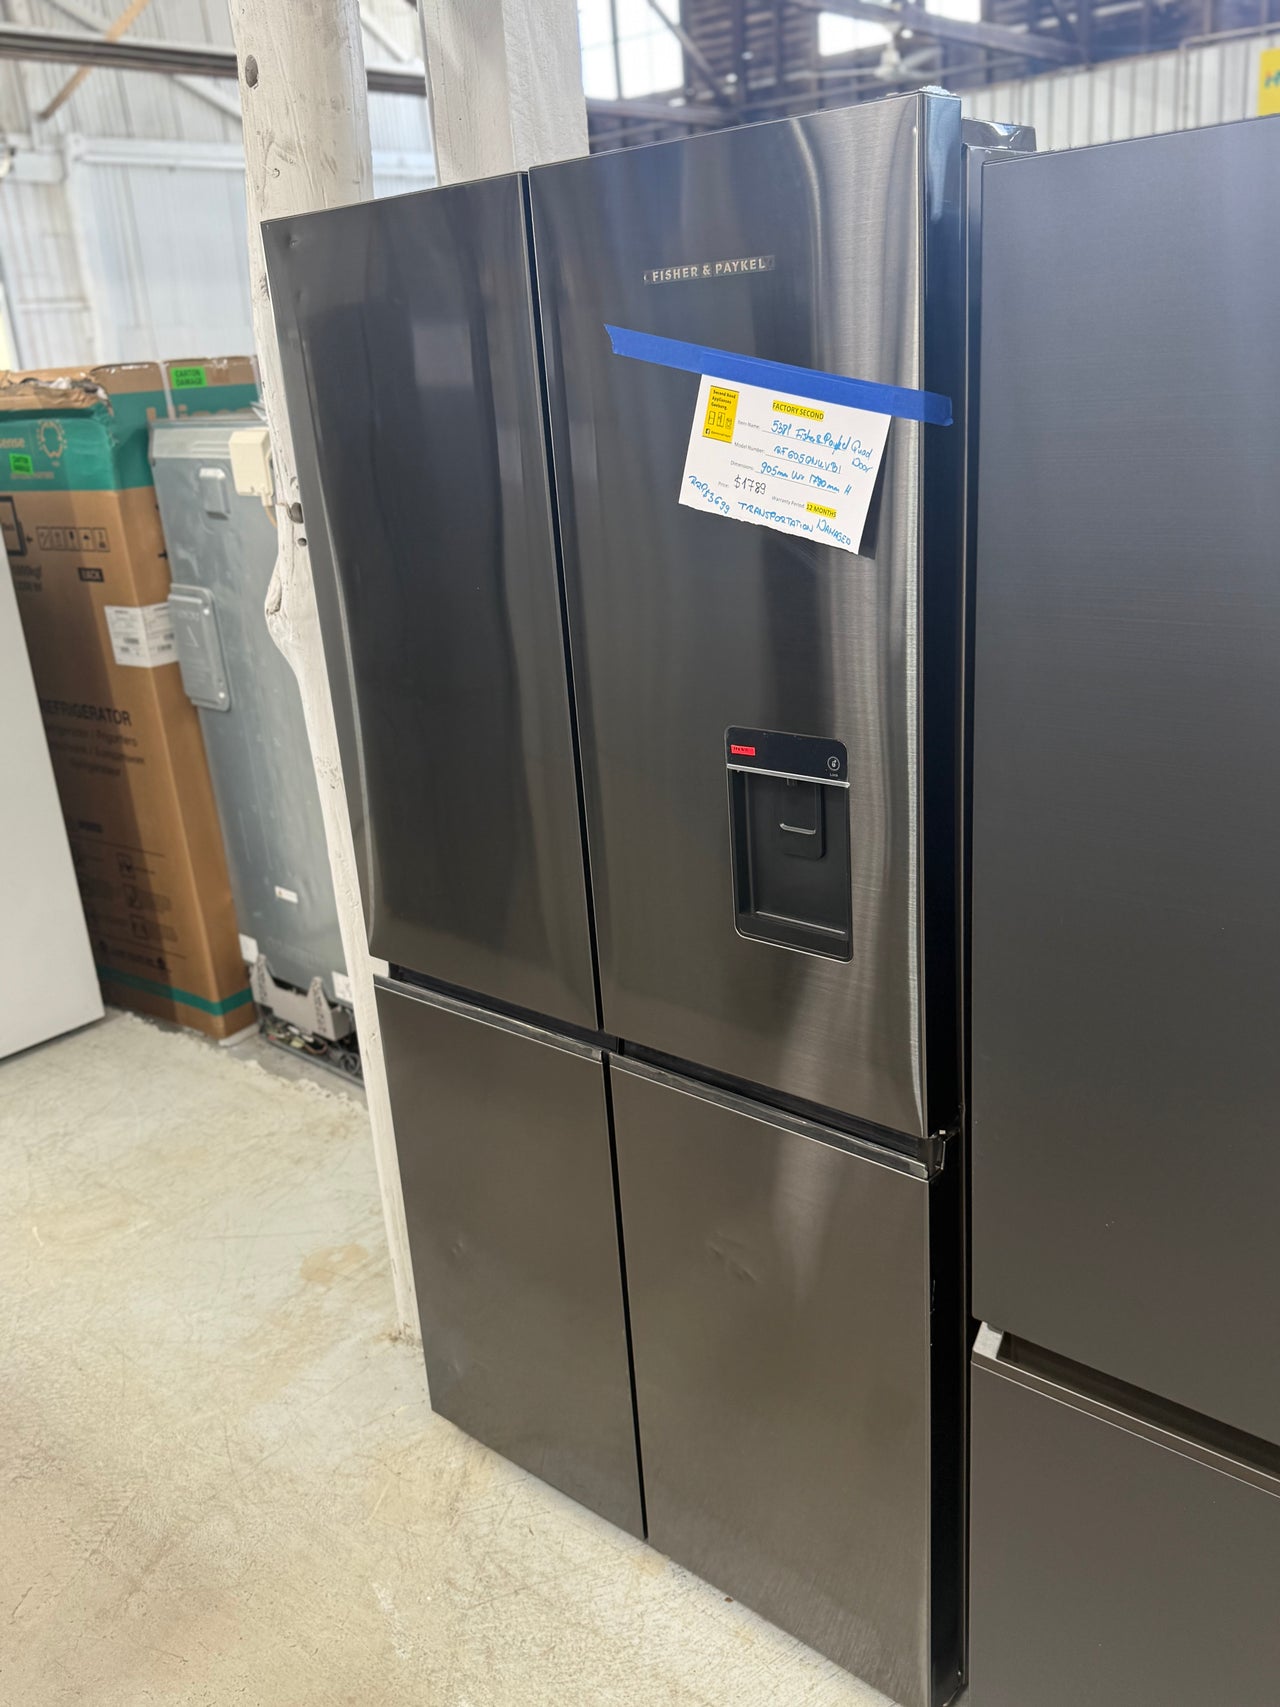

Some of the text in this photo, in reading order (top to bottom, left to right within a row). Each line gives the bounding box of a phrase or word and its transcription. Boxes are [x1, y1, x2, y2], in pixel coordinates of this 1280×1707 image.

[652, 258, 766, 282] FISHER & PAYKEL
[772, 402, 825, 420] FACTORY SECOND
[734, 474, 766, 495] $1789
[737, 501, 814, 532] TRANSPORTATION
[813, 505, 837, 518] MONTHS
